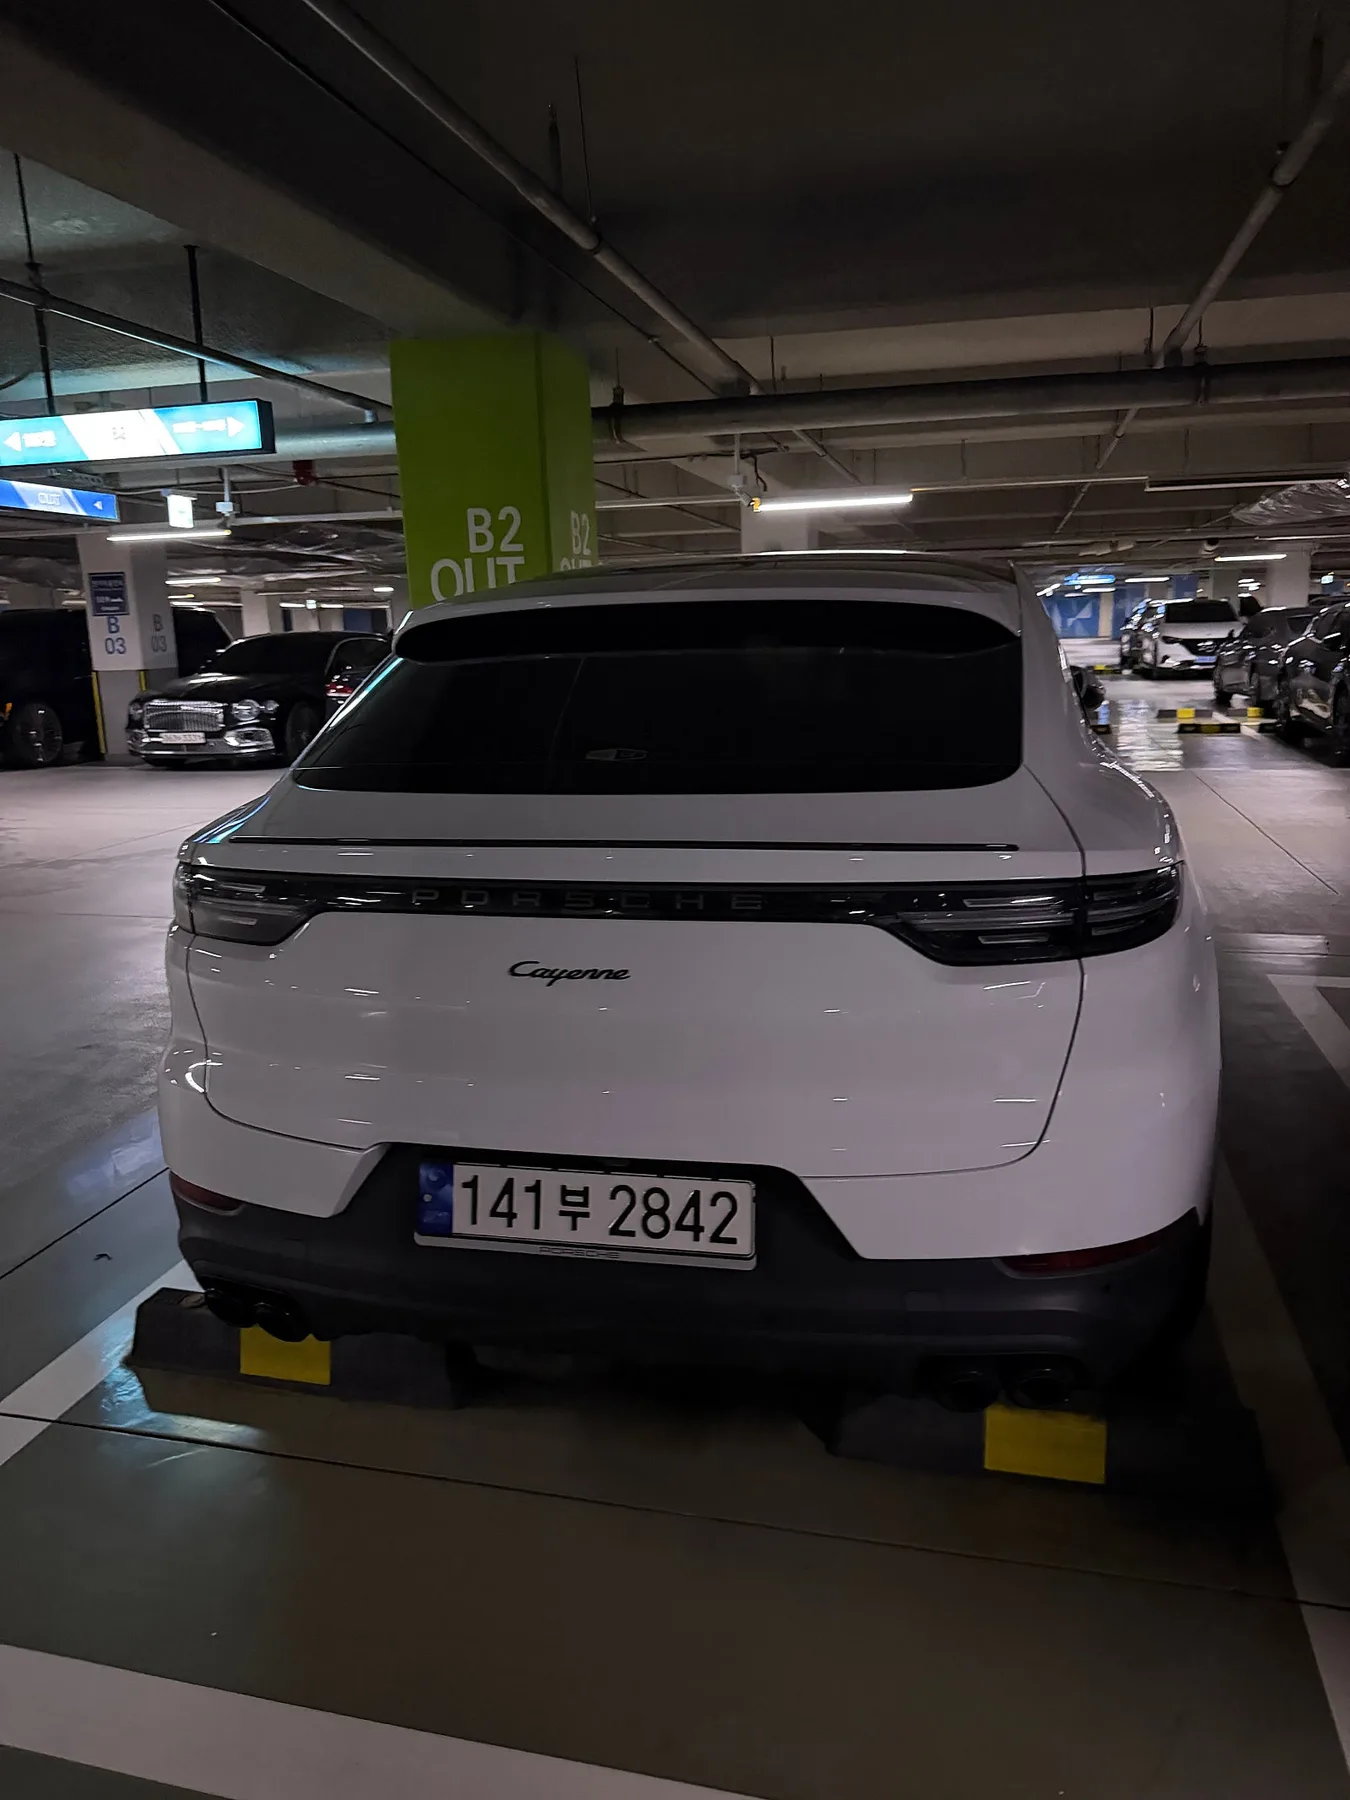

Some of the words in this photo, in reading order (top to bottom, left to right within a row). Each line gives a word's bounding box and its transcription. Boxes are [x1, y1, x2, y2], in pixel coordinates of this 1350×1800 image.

[467, 506, 524, 553] B2
[570, 510, 592, 555] B2
[107, 616, 120, 633] B
[105, 637, 127, 655] 03
[411, 889, 763, 910] PORSCHE
[508, 960, 632, 987] Cayenne
[461, 1174, 590, 1232] 141부
[607, 1184, 739, 1245] 2842
[538, 1246, 621, 1259] PORSCHE
